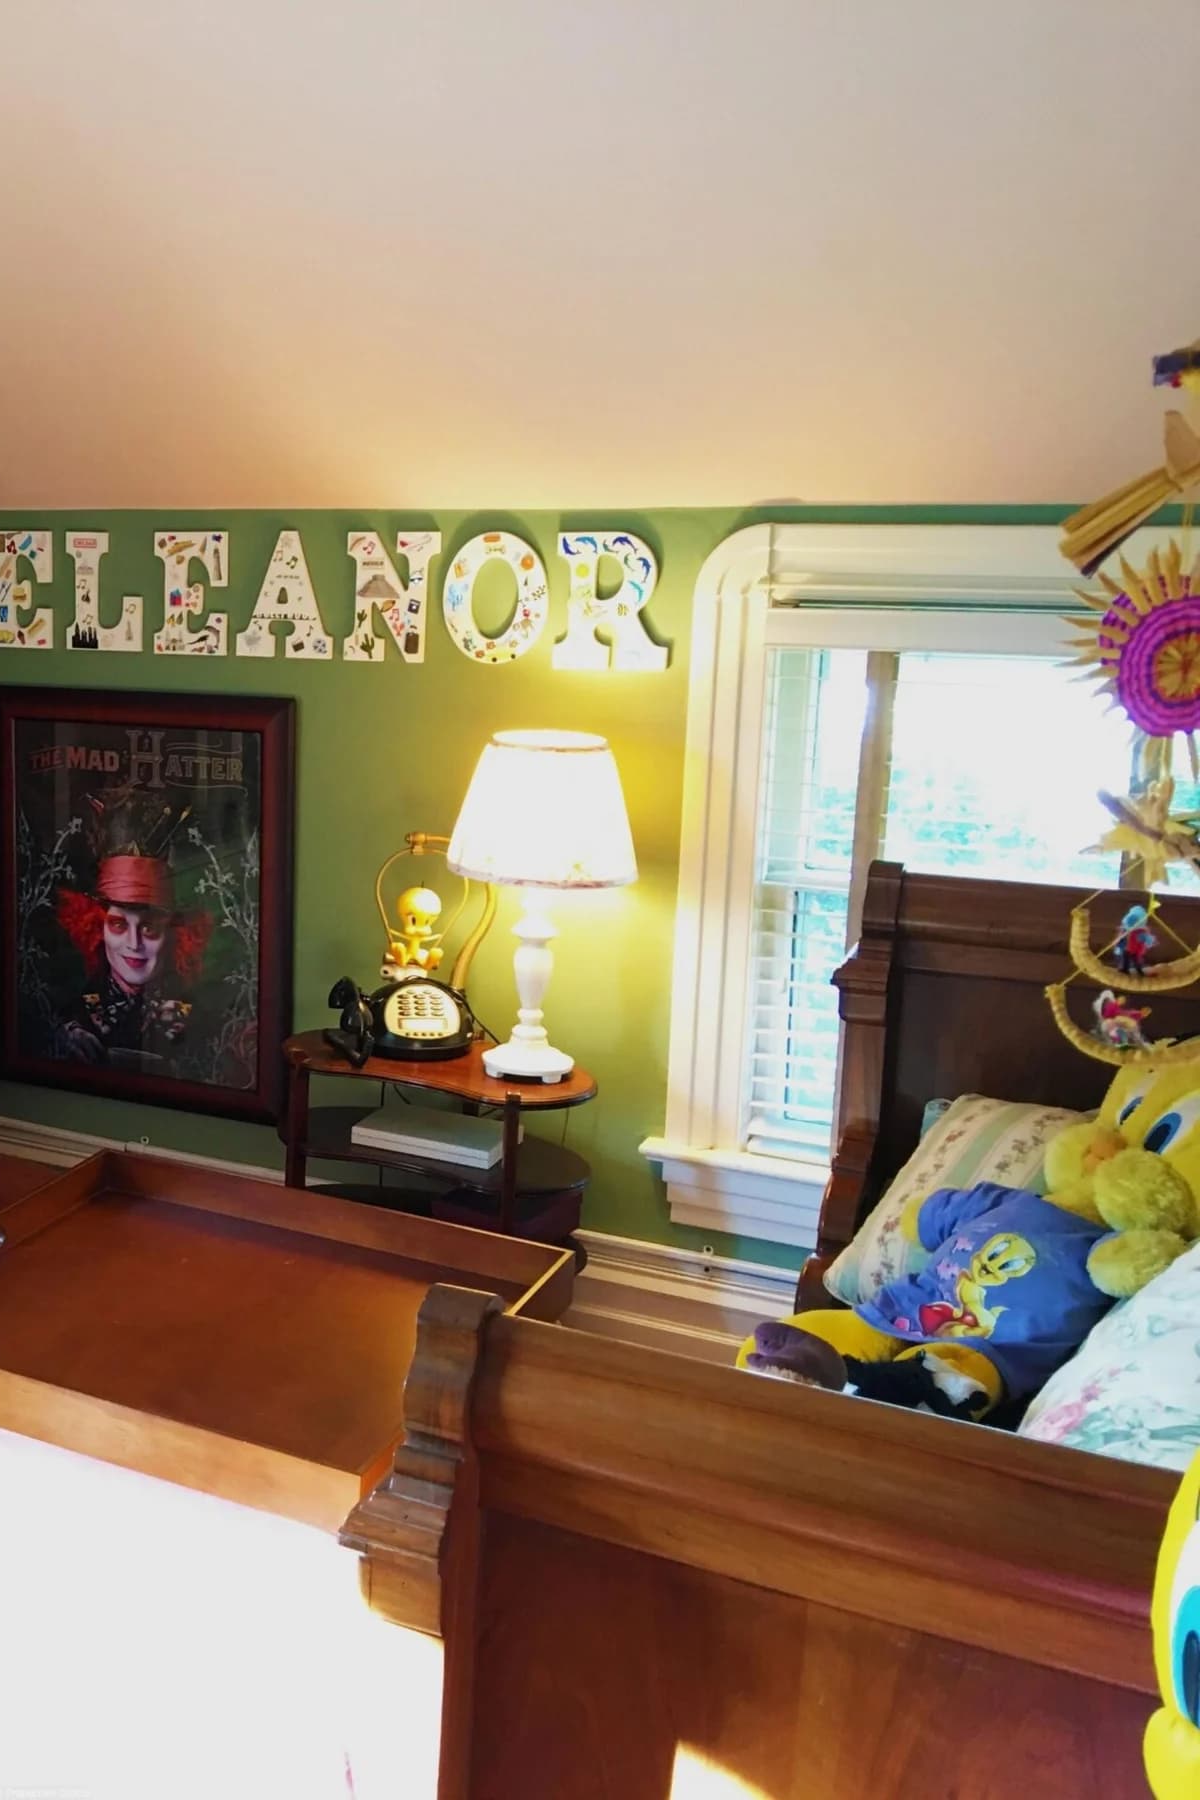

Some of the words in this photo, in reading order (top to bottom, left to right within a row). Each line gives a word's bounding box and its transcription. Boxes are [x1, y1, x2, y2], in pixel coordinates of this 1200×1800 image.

[31, 750, 64, 769] THE
[66, 746, 120, 772] MAD
[125, 729, 243, 788] HATTER
